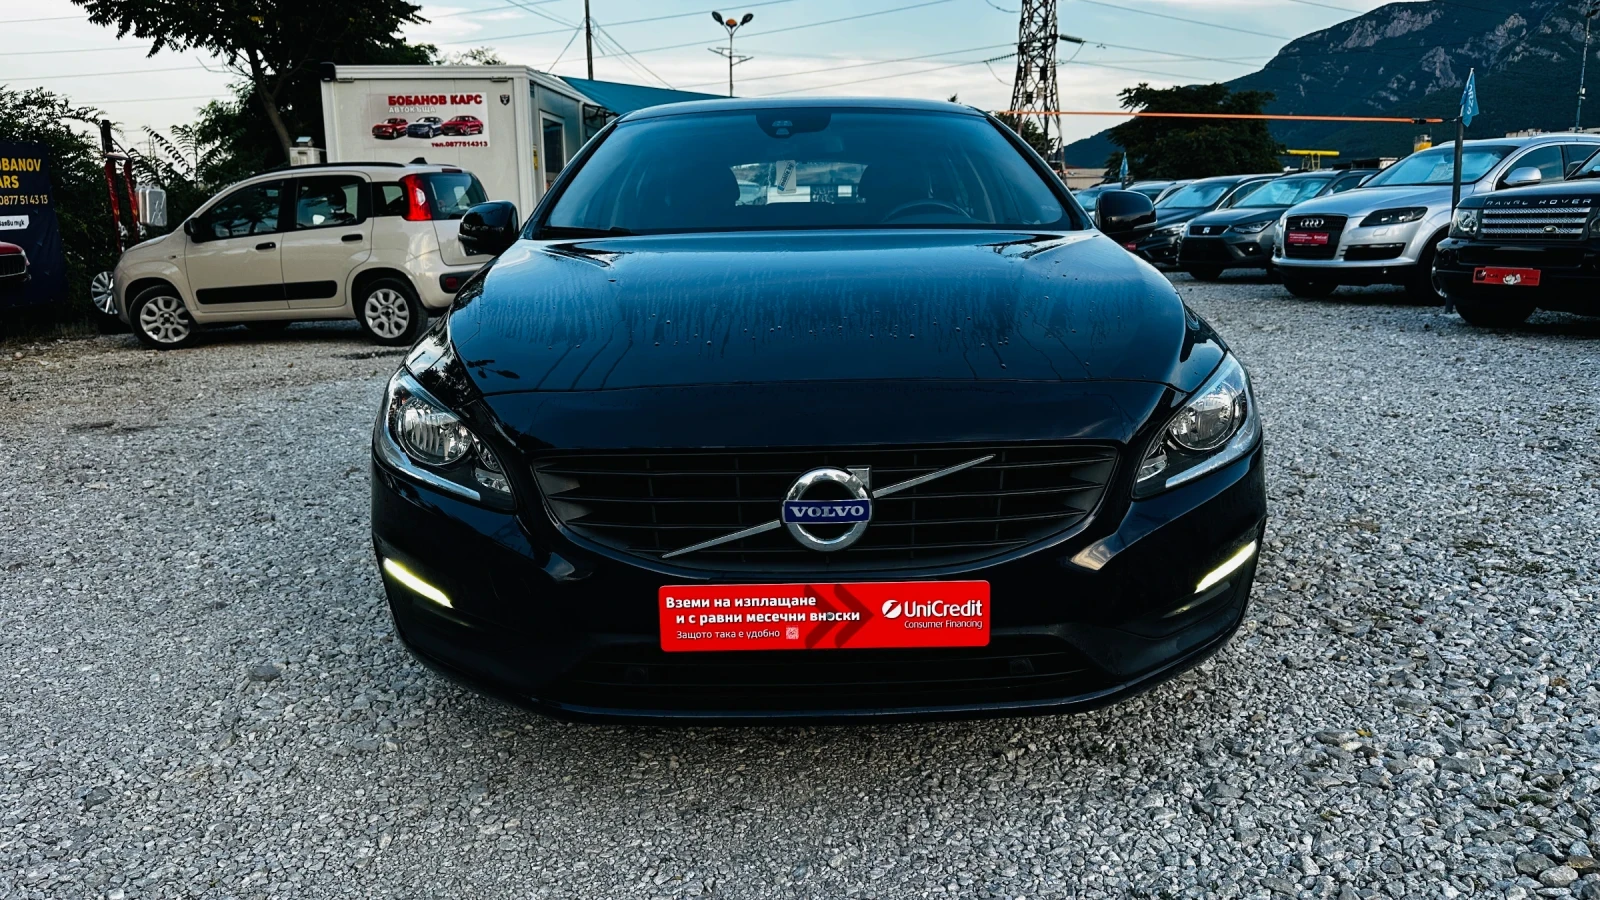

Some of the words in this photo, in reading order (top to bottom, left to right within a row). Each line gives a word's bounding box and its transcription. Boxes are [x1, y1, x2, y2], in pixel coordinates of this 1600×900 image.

[388, 95, 447, 106] БОБАНОВ
[450, 94, 483, 105] КАРС
[0, 157, 41, 171] BANOV
[20, 195, 28, 205] 51
[29, 195, 40, 205] 43
[40, 194, 48, 204] 13
[789, 505, 865, 518] VOLVO
[665, 597, 710, 609] Вземи
[713, 598, 731, 608] на
[734, 596, 817, 609] изплащане
[904, 599, 983, 618] UniCredit
[676, 615, 685, 624] и
[688, 614, 697, 624] с
[699, 613, 743, 626] равни
[746, 612, 806, 623] месечни
[809, 611, 860, 621] вноски
[904, 619, 943, 629] Consumer
[945, 619, 983, 630] Financing
[676, 630, 713, 640] Защото
[715, 631, 736, 639] така
[746, 629, 780, 640] удобно
